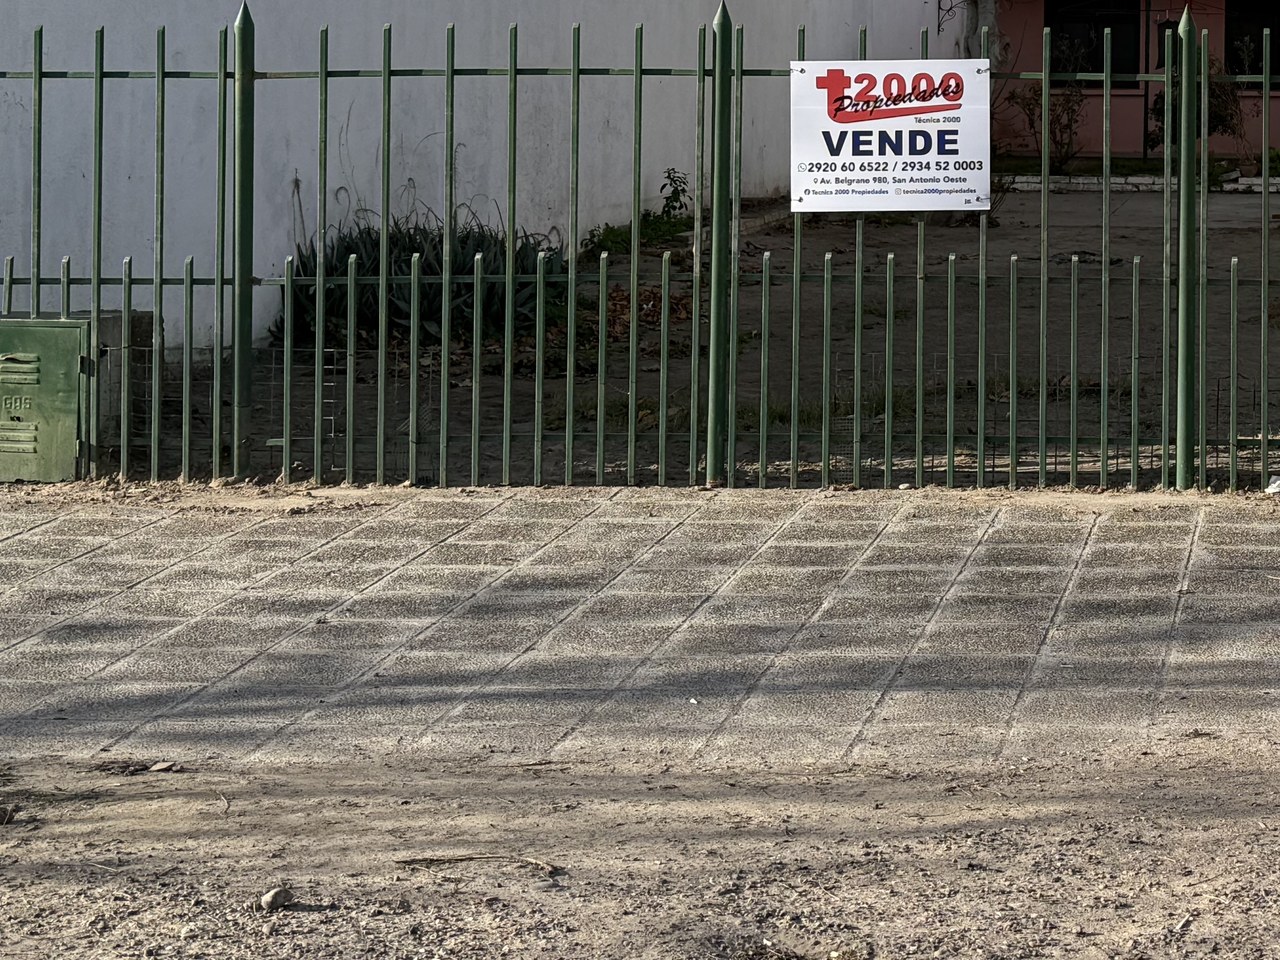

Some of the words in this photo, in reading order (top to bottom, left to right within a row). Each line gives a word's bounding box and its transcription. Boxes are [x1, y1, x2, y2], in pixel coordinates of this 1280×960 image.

[832, 79, 963, 118] Propiedades
[914, 116, 941, 124] Técnica
[821, 129, 960, 157] VENDE
[807, 161, 837, 173] 2920
[840, 161, 856, 172] 60
[859, 161, 889, 172] 6522
[892, 160, 898, 172] /
[901, 160, 931, 171] 2934
[935, 160, 950, 171] 52
[953, 160, 984, 171] 0003
[819, 177, 833, 185] Av.
[834, 176, 871, 186] Belgrano
[872, 176, 890, 185] 980,
[892, 176, 907, 184] San
[908, 176, 942, 184] Antonio
[943, 175, 968, 183] Oeste
[851, 188, 889, 196] Propiedades
[902, 187, 977, 196] tecnica2000propiedades
